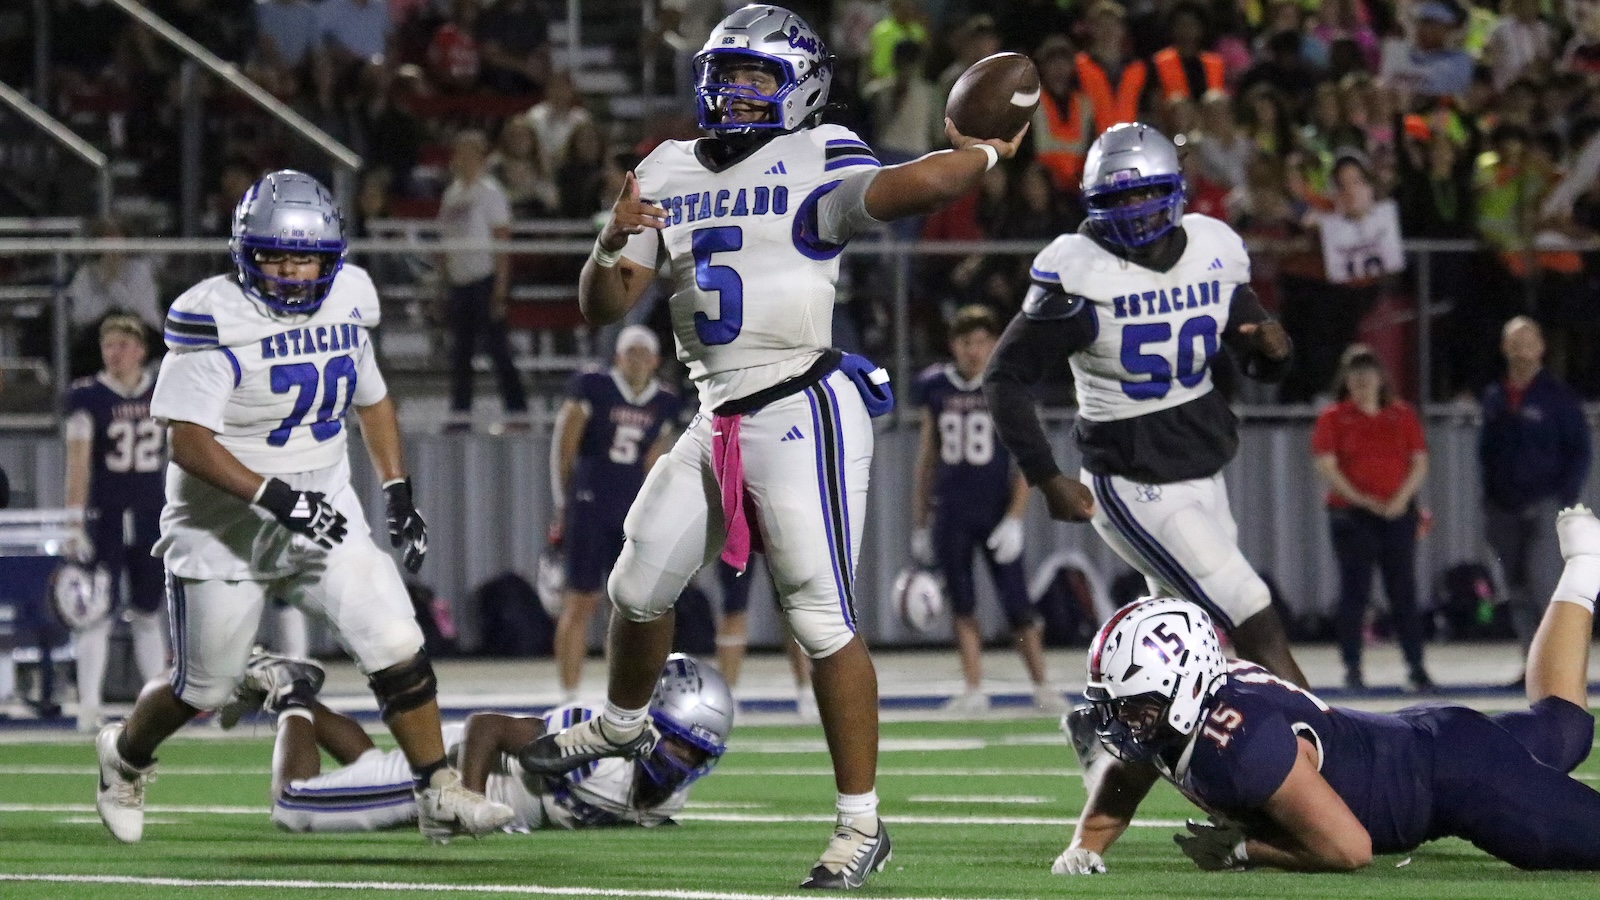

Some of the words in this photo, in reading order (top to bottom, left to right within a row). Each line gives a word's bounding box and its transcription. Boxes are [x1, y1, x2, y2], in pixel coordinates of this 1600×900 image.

[691, 225, 744, 346] 5
[1112, 280, 1220, 319] ESTACADO
[260, 323, 360, 360] ESTACADO
[1119, 315, 1218, 402] 50
[266, 354, 358, 448] 70
[105, 420, 163, 473] 32
[609, 425, 645, 464] 5
[938, 411, 994, 466] 88
[1141, 621, 1186, 666] 15
[1203, 703, 1246, 748] 15
